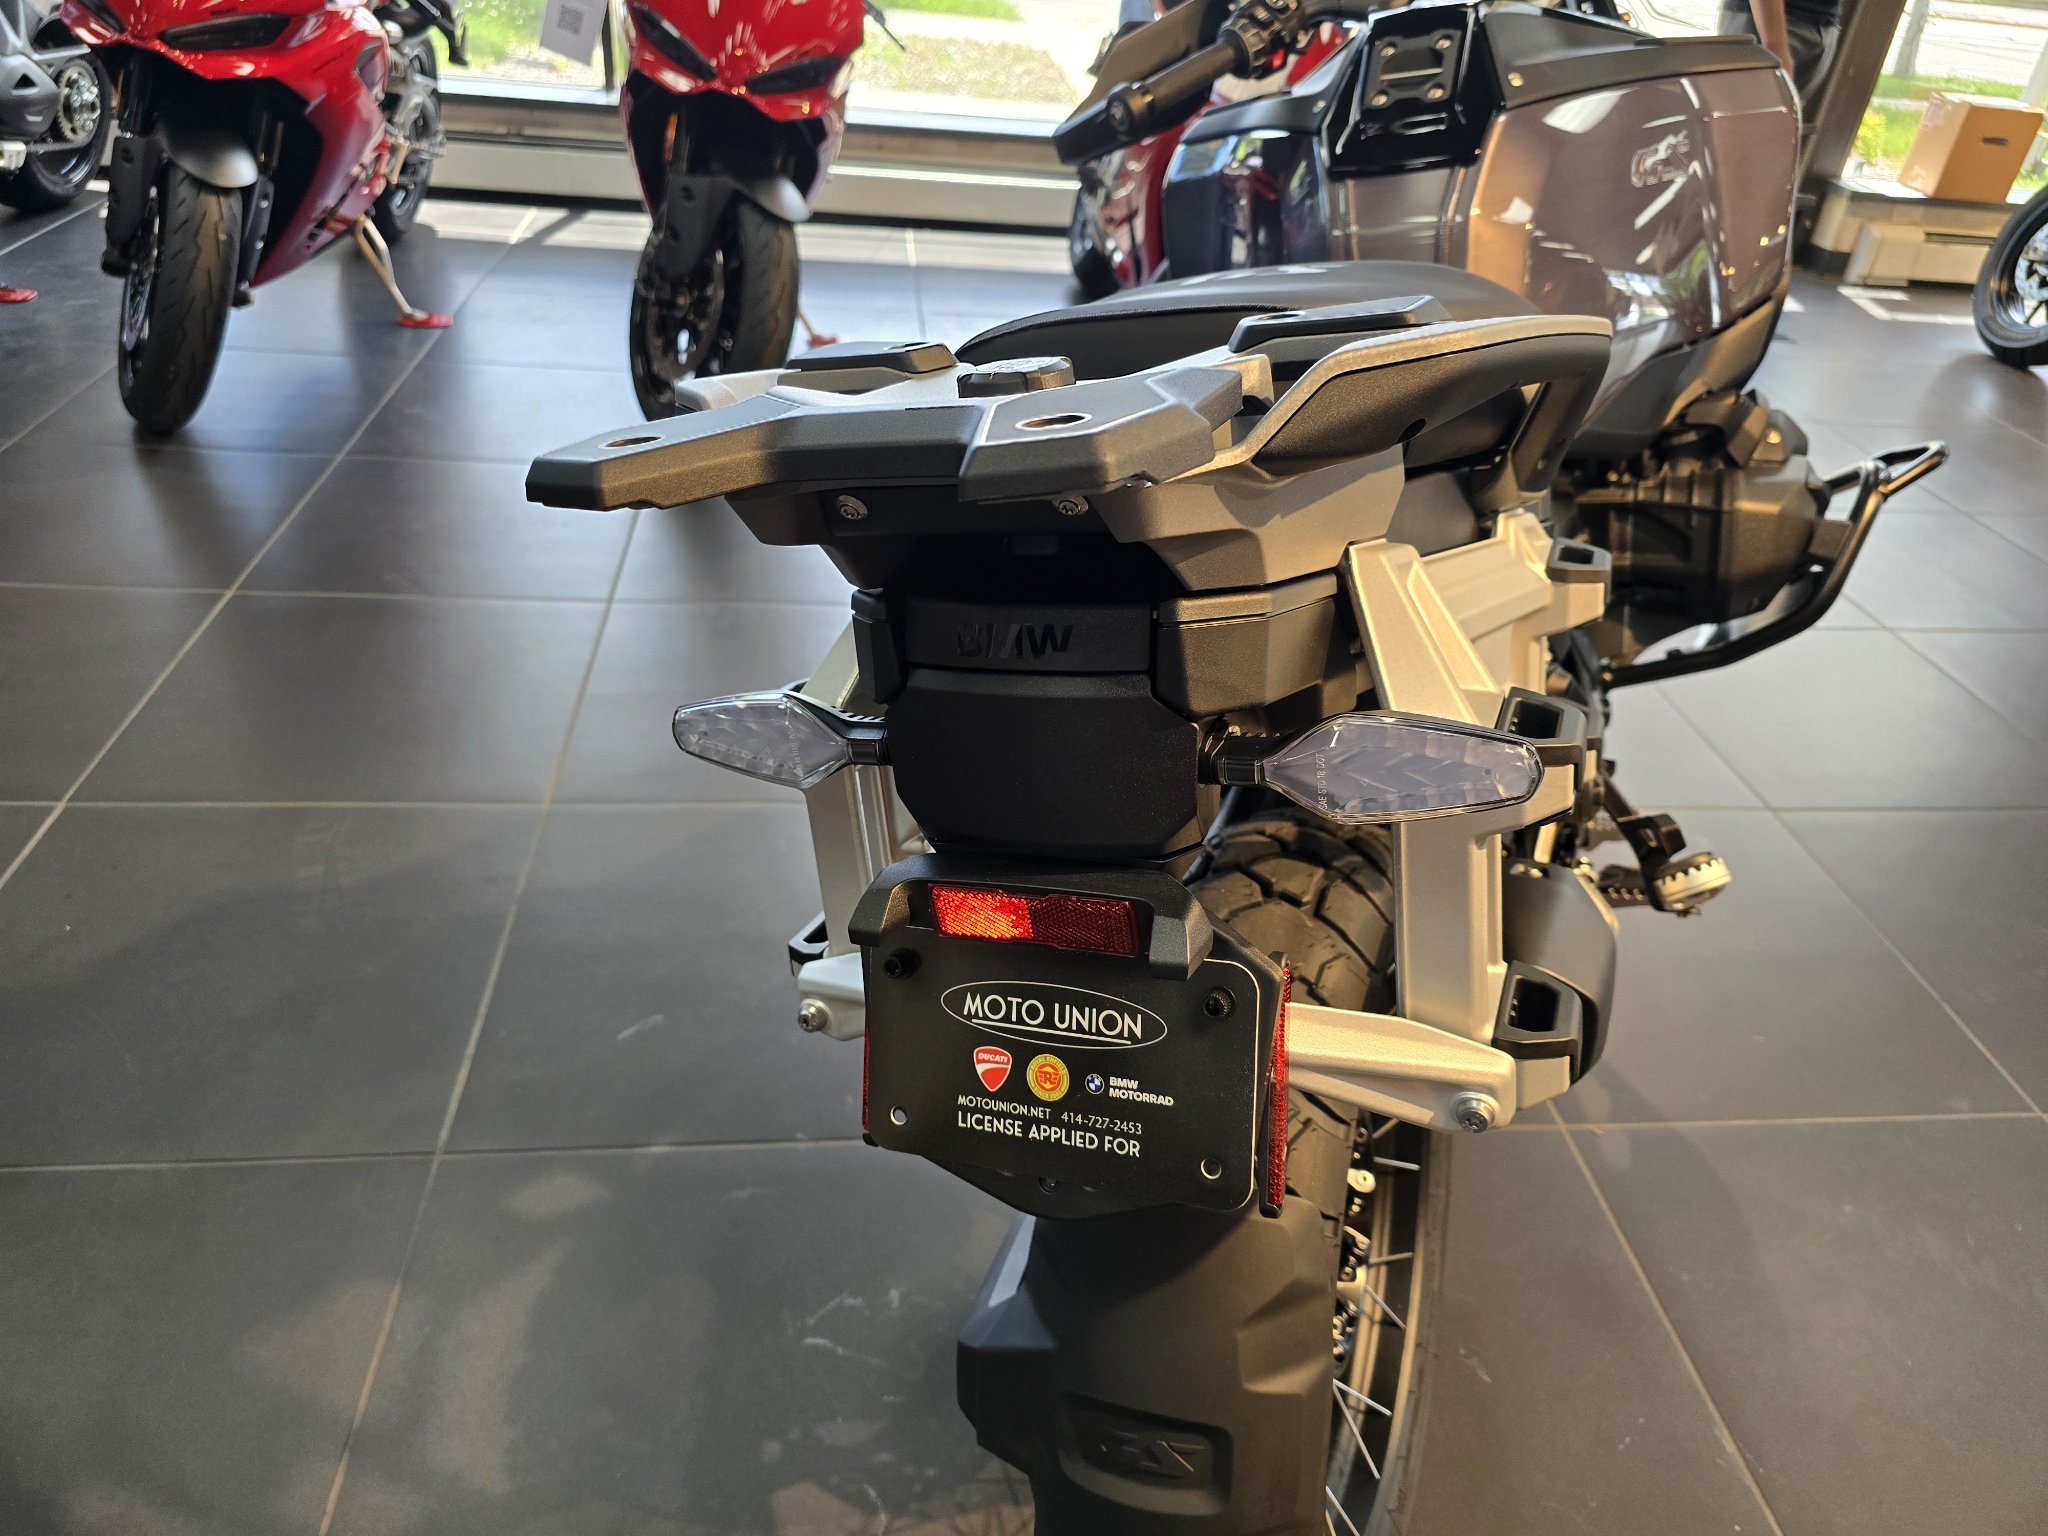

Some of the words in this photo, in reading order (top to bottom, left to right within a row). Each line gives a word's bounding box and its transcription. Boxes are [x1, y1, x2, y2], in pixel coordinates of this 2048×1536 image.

[1317, 795, 1329, 810] SAE
[963, 991, 1045, 1025] MOTO
[1054, 1002, 1142, 1040] UNION
[978, 1052, 1008, 1064] DUCATI
[1109, 1076, 1139, 1090] BMW
[1108, 1087, 1175, 1106] MOTORRAD
[957, 1094, 1052, 1120] MOTOUNION.NET
[1061, 1111, 1143, 1135] 414-727-2453
[958, 1110, 1023, 1137] LICENSE
[1028, 1123, 1099, 1149] APPLIED
[1104, 1135, 1141, 1158] FOR
